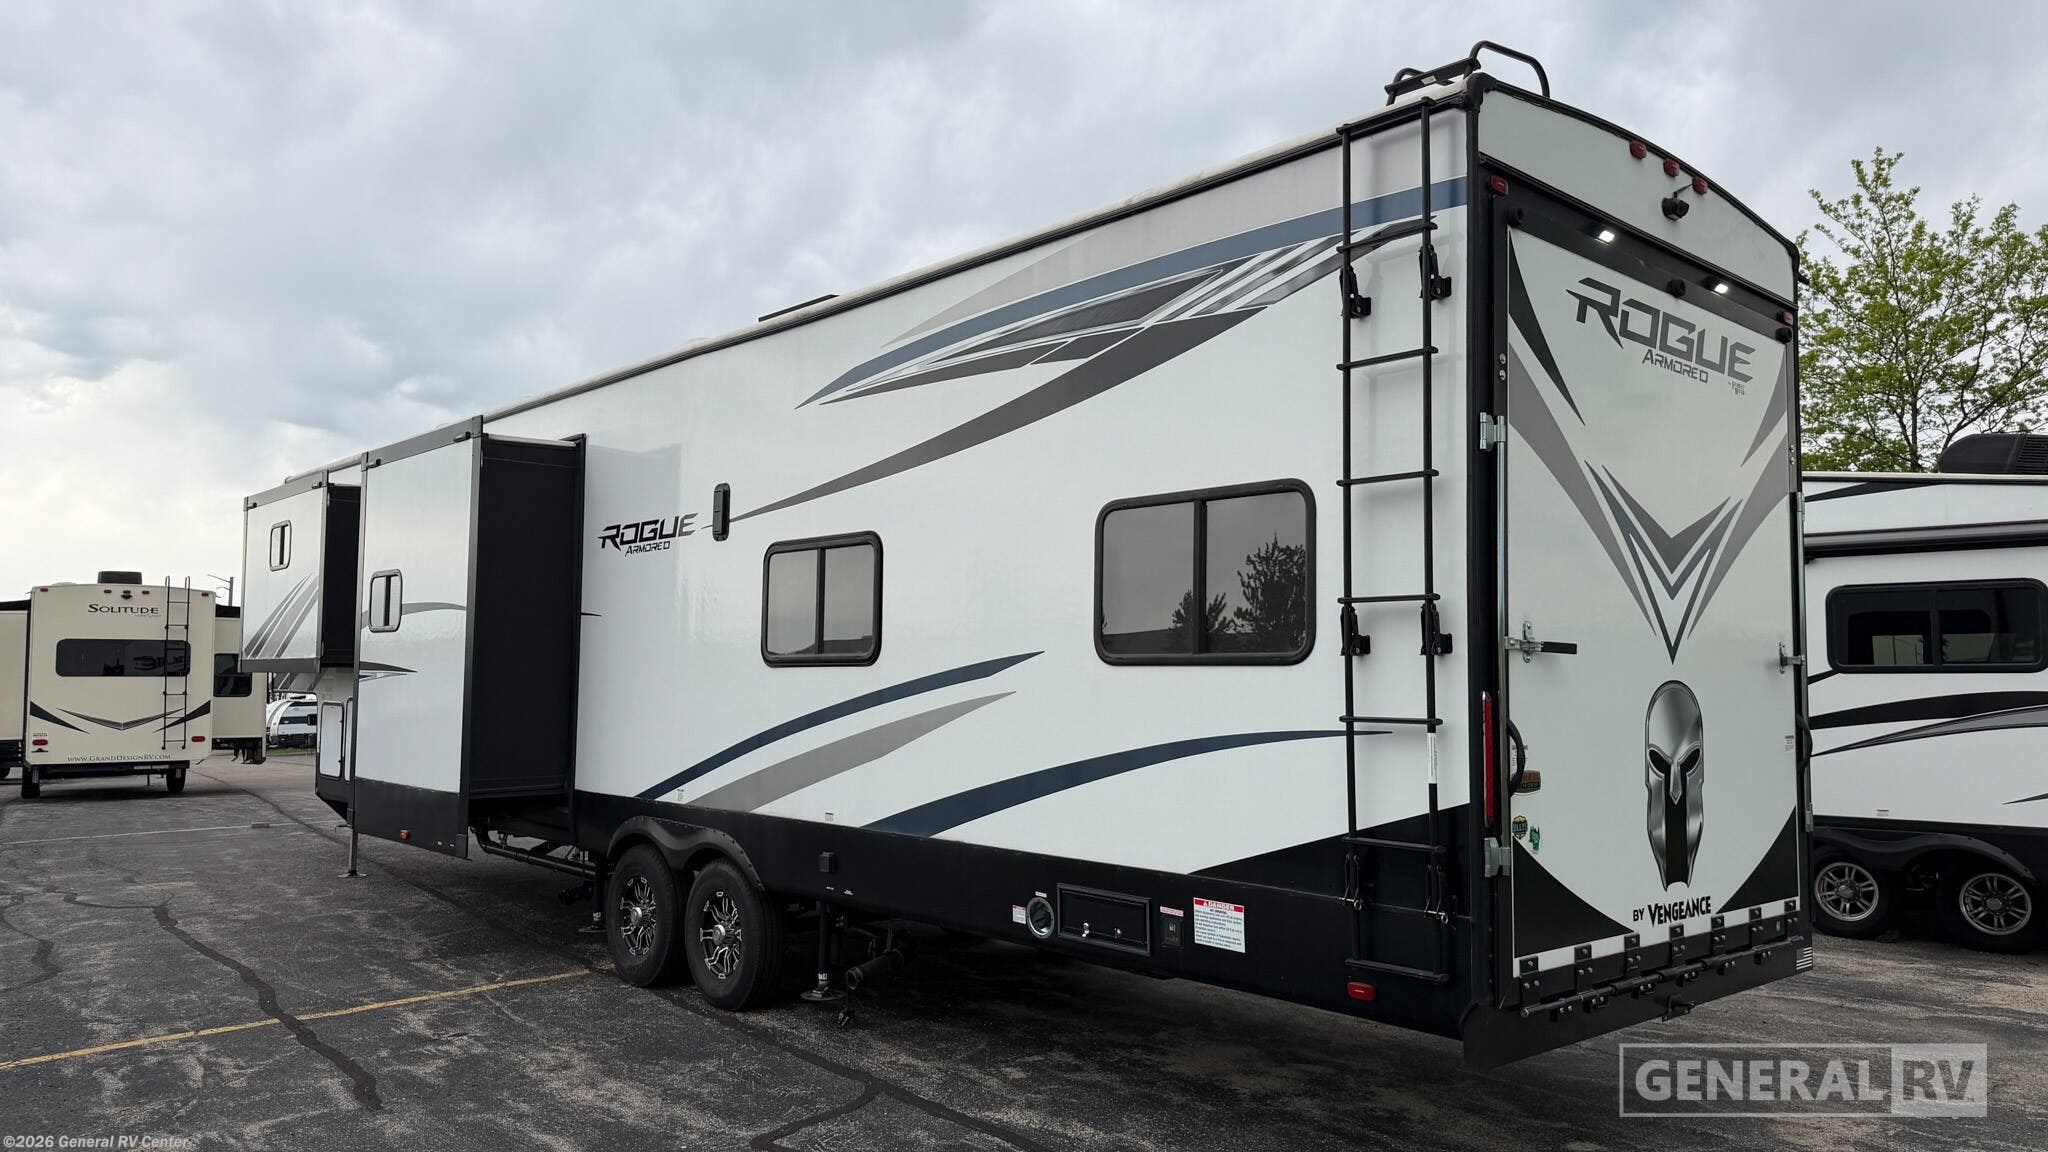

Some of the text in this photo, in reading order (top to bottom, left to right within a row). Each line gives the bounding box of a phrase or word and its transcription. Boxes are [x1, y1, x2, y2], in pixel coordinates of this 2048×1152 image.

[1565, 277, 1756, 383] ROGUE
[1641, 349, 1709, 384] ARMORED
[597, 512, 699, 551] ROGUE
[624, 540, 671, 557] ARMORED
[88, 603, 161, 615] SOLITUDE
[1632, 895, 1712, 928] BY VENGEANCE
